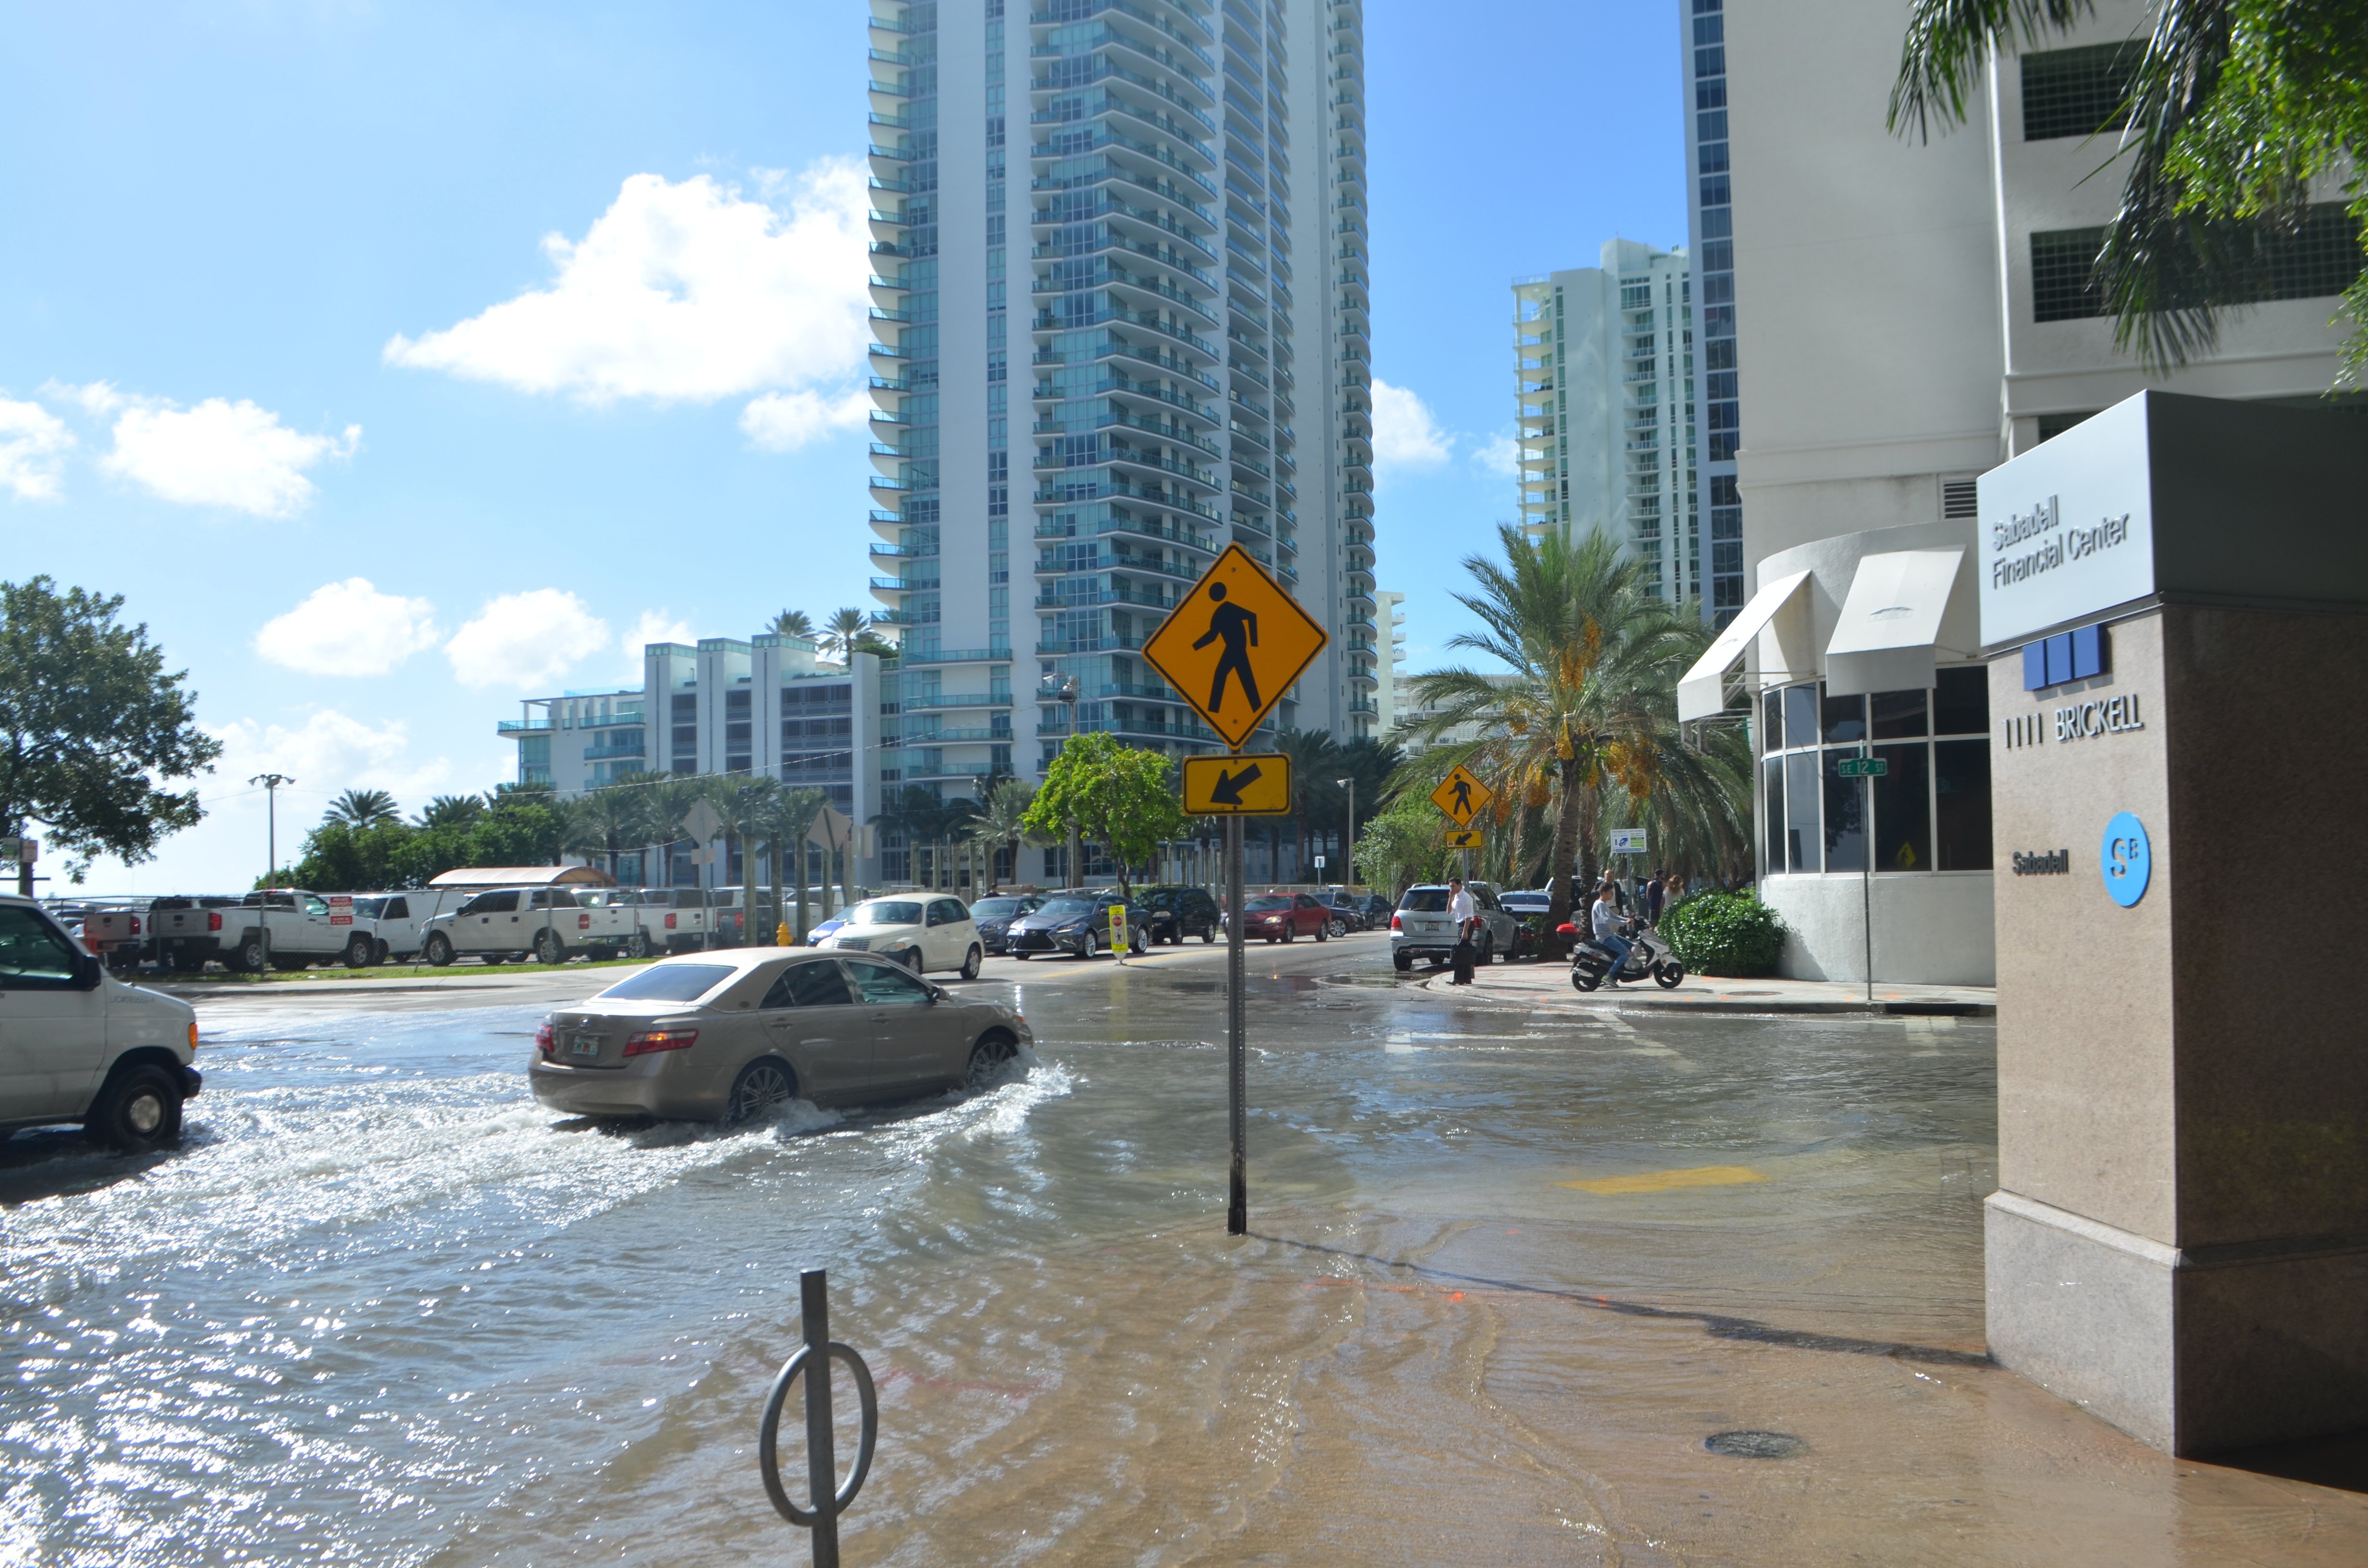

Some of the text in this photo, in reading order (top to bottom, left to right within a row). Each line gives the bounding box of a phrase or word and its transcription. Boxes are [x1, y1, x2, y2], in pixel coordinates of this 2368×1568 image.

[1992, 493, 2059, 552] Sabadell
[1993, 513, 2130, 590] Financial Center
[2002, 693, 2144, 748] 1111 BRICKELL
[1841, 761, 1884, 774] SE 12 ST
[2012, 849, 2069, 876] Sabadell
